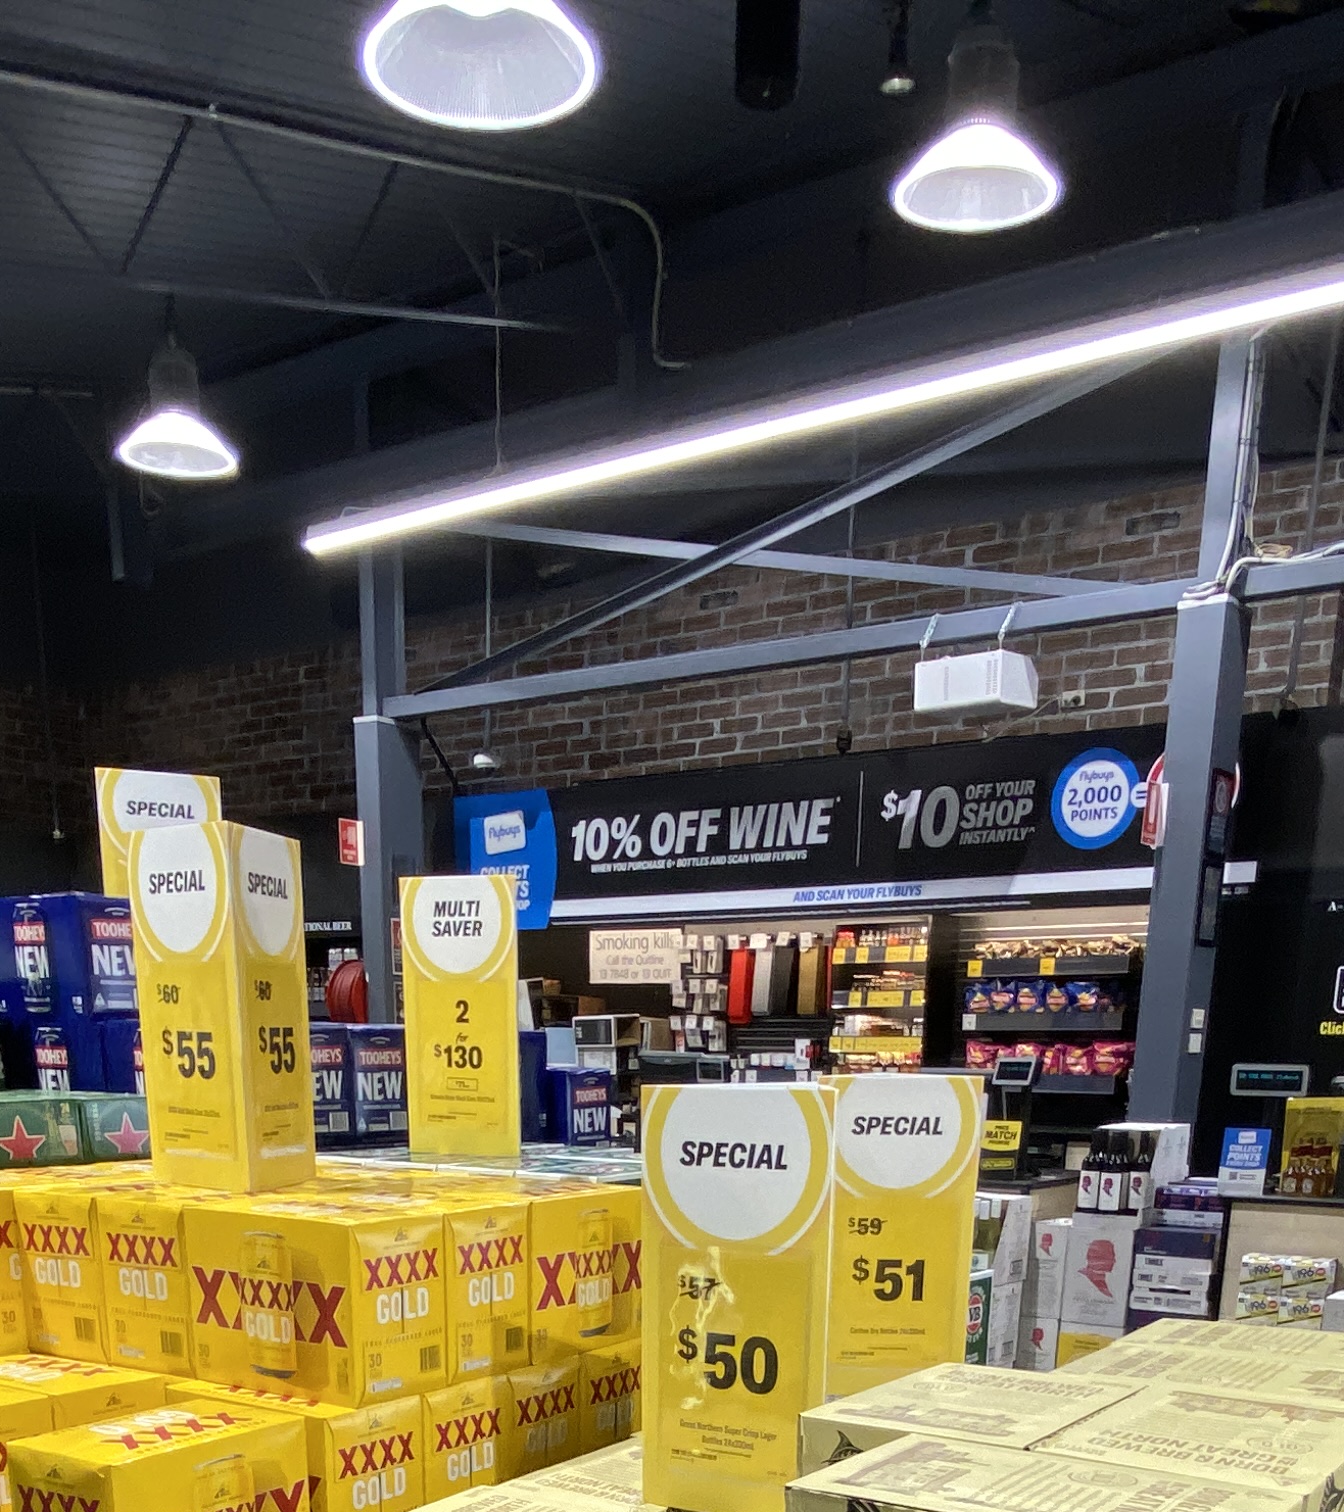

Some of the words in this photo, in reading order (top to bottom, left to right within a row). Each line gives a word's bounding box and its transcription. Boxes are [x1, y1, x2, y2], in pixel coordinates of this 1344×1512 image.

[1079, 770, 1114, 784] flybuys
[966, 784, 993, 799] OFF
[996, 780, 1036, 797] YOUR
[1067, 786, 1121, 806] 2,000
[126, 800, 195, 820] SPECIAL
[881, 786, 960, 849] $10
[960, 799, 1033, 828] SHOP
[1071, 806, 1118, 822] POINTS
[572, 814, 642, 861] 10%
[650, 809, 722, 856] OFF
[591, 863, 611, 874] WHEN
[613, 862, 626, 872] YOU
[627, 860, 665, 871] PURCHASE
[677, 857, 708, 868] BOTTLES
[710, 856, 726, 865] AND
[727, 854, 748, 864] SCAN
[750, 852, 770, 862] YOUR
[772, 850, 807, 861] FLYBUYS
[148, 870, 205, 895] SPECIAL
[248, 872, 288, 899] SPECIAL
[793, 891, 815, 902] AND
[817, 888, 847, 901] SCAN
[848, 888, 875, 899] YOUR
[876, 885, 922, 898] FLYBUYS
[434, 901, 480, 918] MULTI
[332, 922, 352, 931] BEER
[432, 921, 482, 937] SAVER
[596, 933, 649, 954] Smoking
[456, 1001, 469, 1023] 2
[162, 1030, 216, 1080] $55
[259, 1026, 296, 1074] $55
[360, 1050, 401, 1066] TOOHEYS
[434, 1044, 482, 1069] $130
[357, 1071, 403, 1101] NEW
[576, 1088, 606, 1102] TOOHEYS
[573, 1107, 606, 1134] NEW
[851, 1116, 944, 1136] SPECIAL
[984, 1130, 1018, 1140] MATCH
[679, 1141, 788, 1170] SPECIAL
[1227, 1153, 1261, 1161] POINTS
[364, 1247, 439, 1292] XXXX
[851, 1255, 926, 1302] $51
[376, 1287, 430, 1325] GOLD
[968, 1305, 981, 1321] VB
[678, 1325, 778, 1395] $50
[338, 1431, 416, 1480] XXXX
[352, 1467, 407, 1510] GOLD
